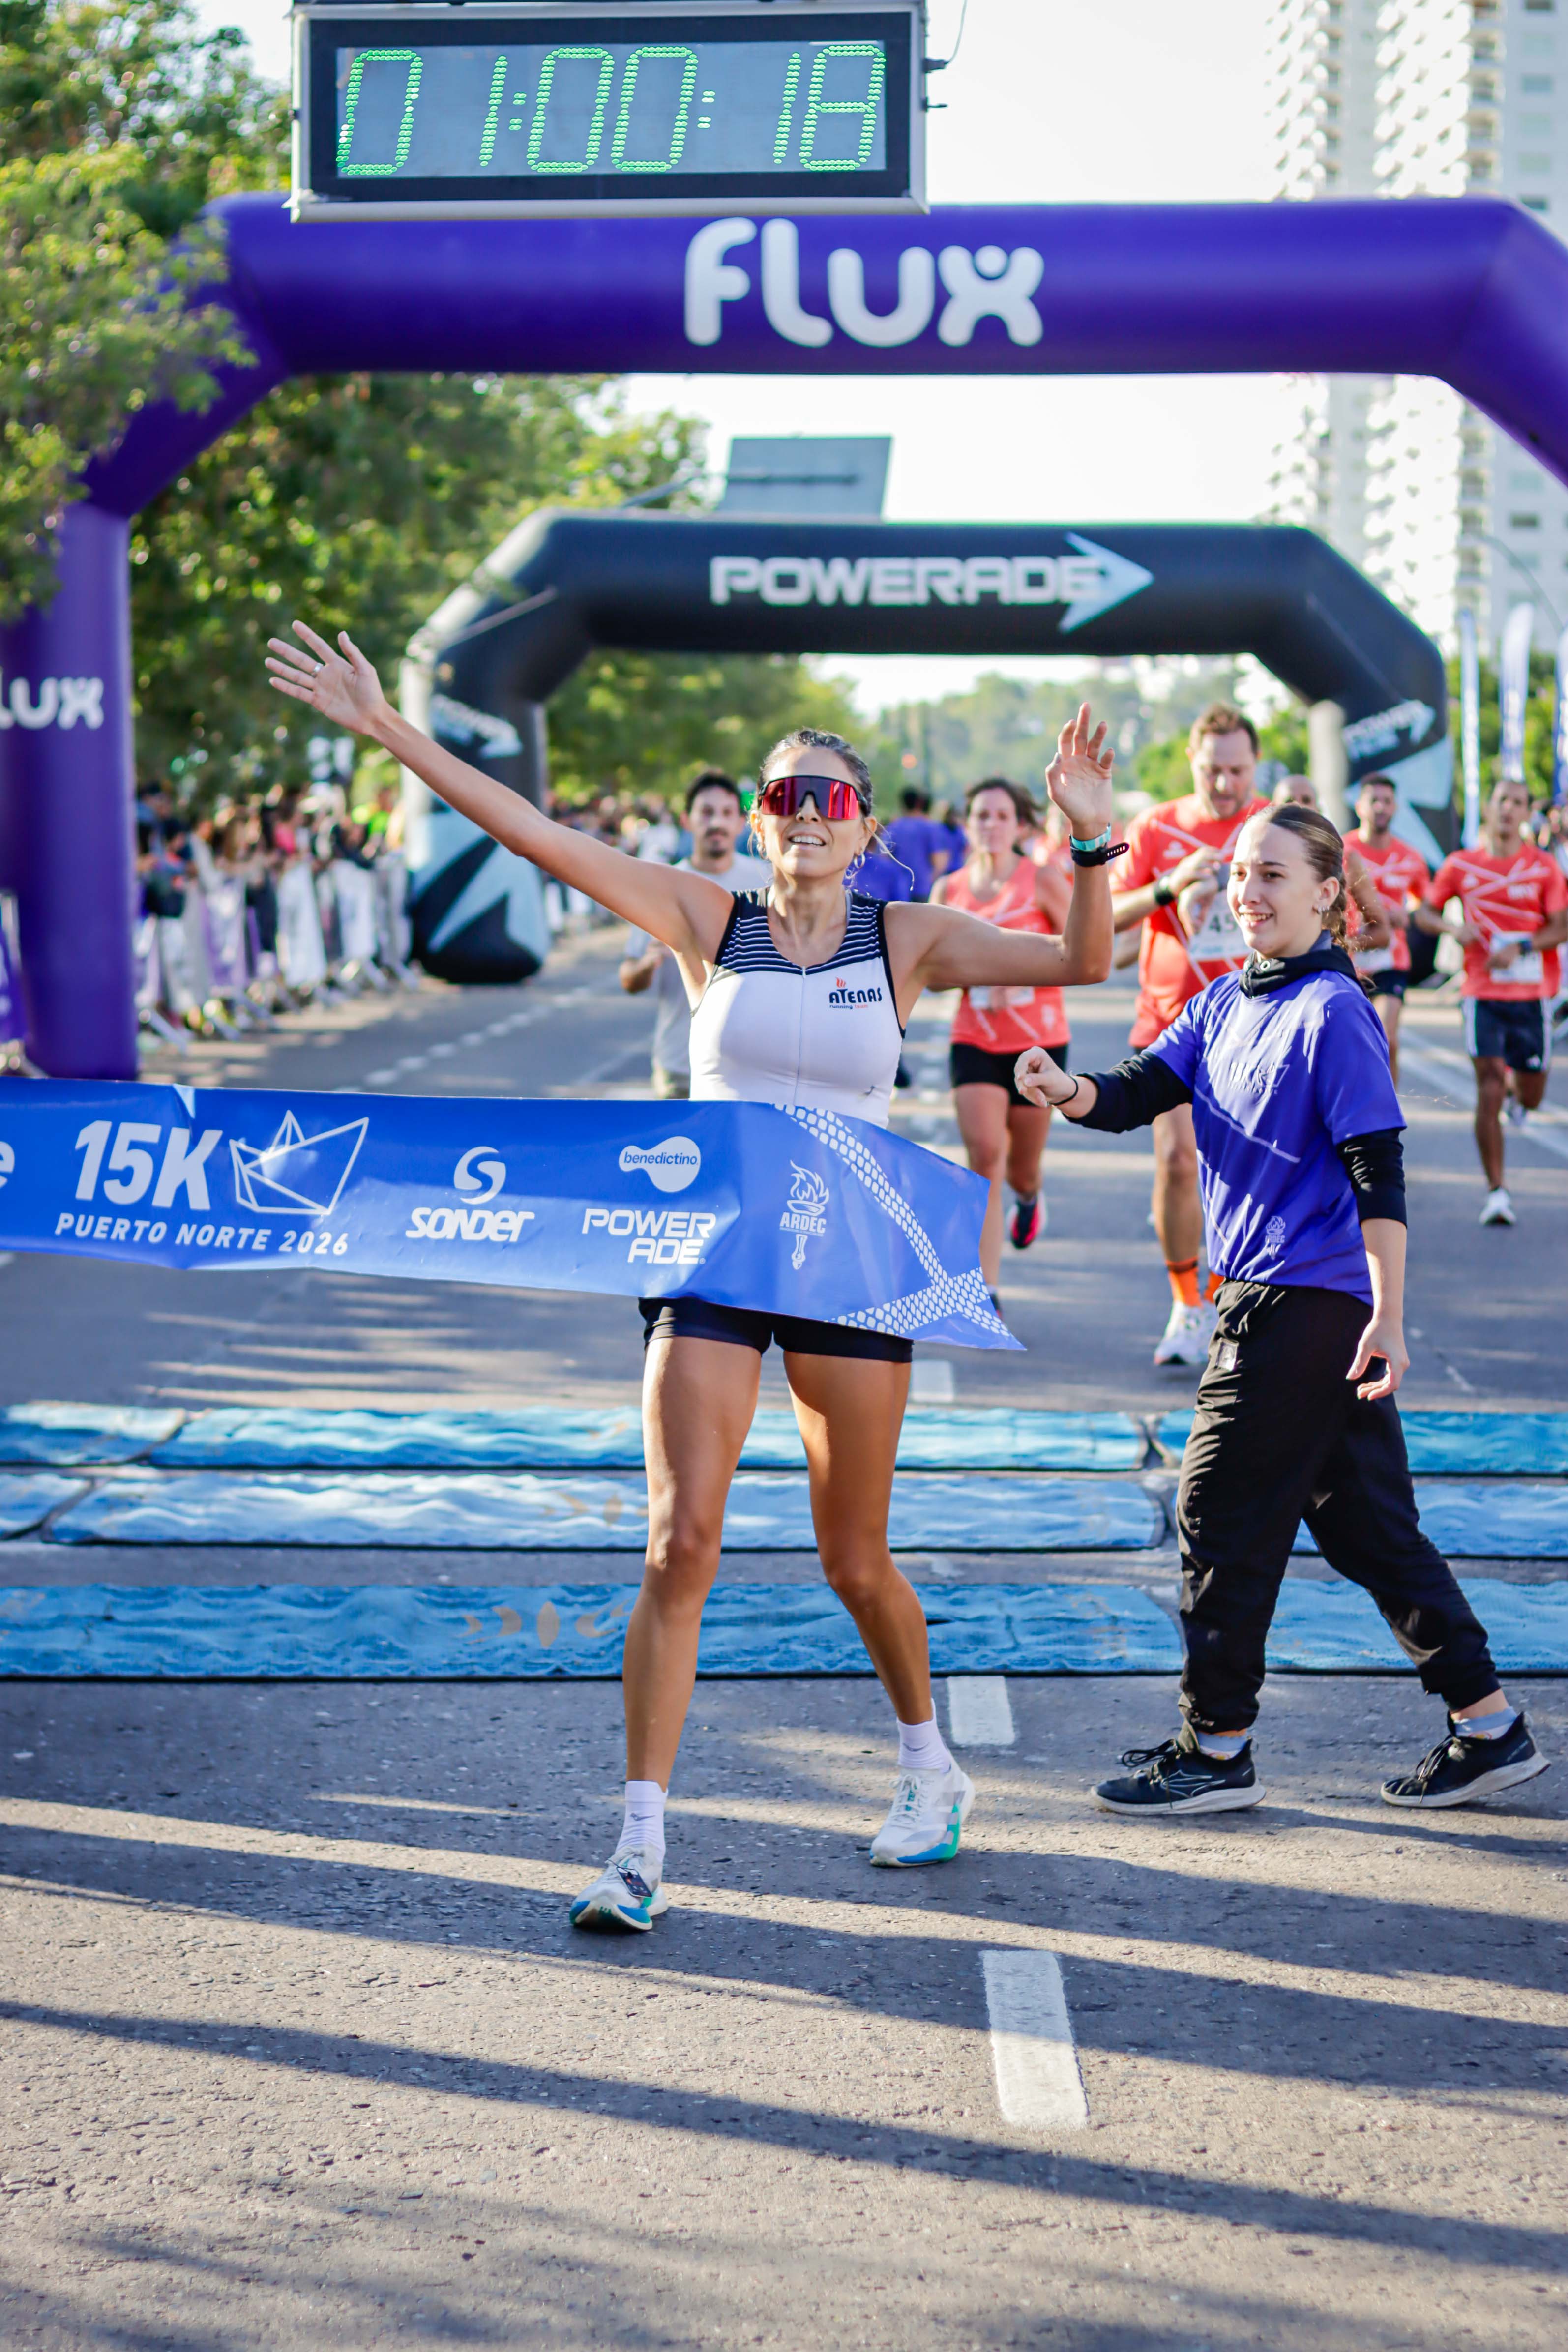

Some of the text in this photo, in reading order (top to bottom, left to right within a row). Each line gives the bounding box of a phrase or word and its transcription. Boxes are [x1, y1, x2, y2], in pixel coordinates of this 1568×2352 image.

[710, 556, 1102, 606] POWERADE
[829, 987, 882, 1004] ATENAS
[75, 1120, 223, 1210] 15K
[624, 1151, 697, 1165] benedictino
[55, 1212, 348, 1255] PUERTO NORTE 2026
[582, 1208, 716, 1237] POWER
[780, 1212, 827, 1234] ARDEC
